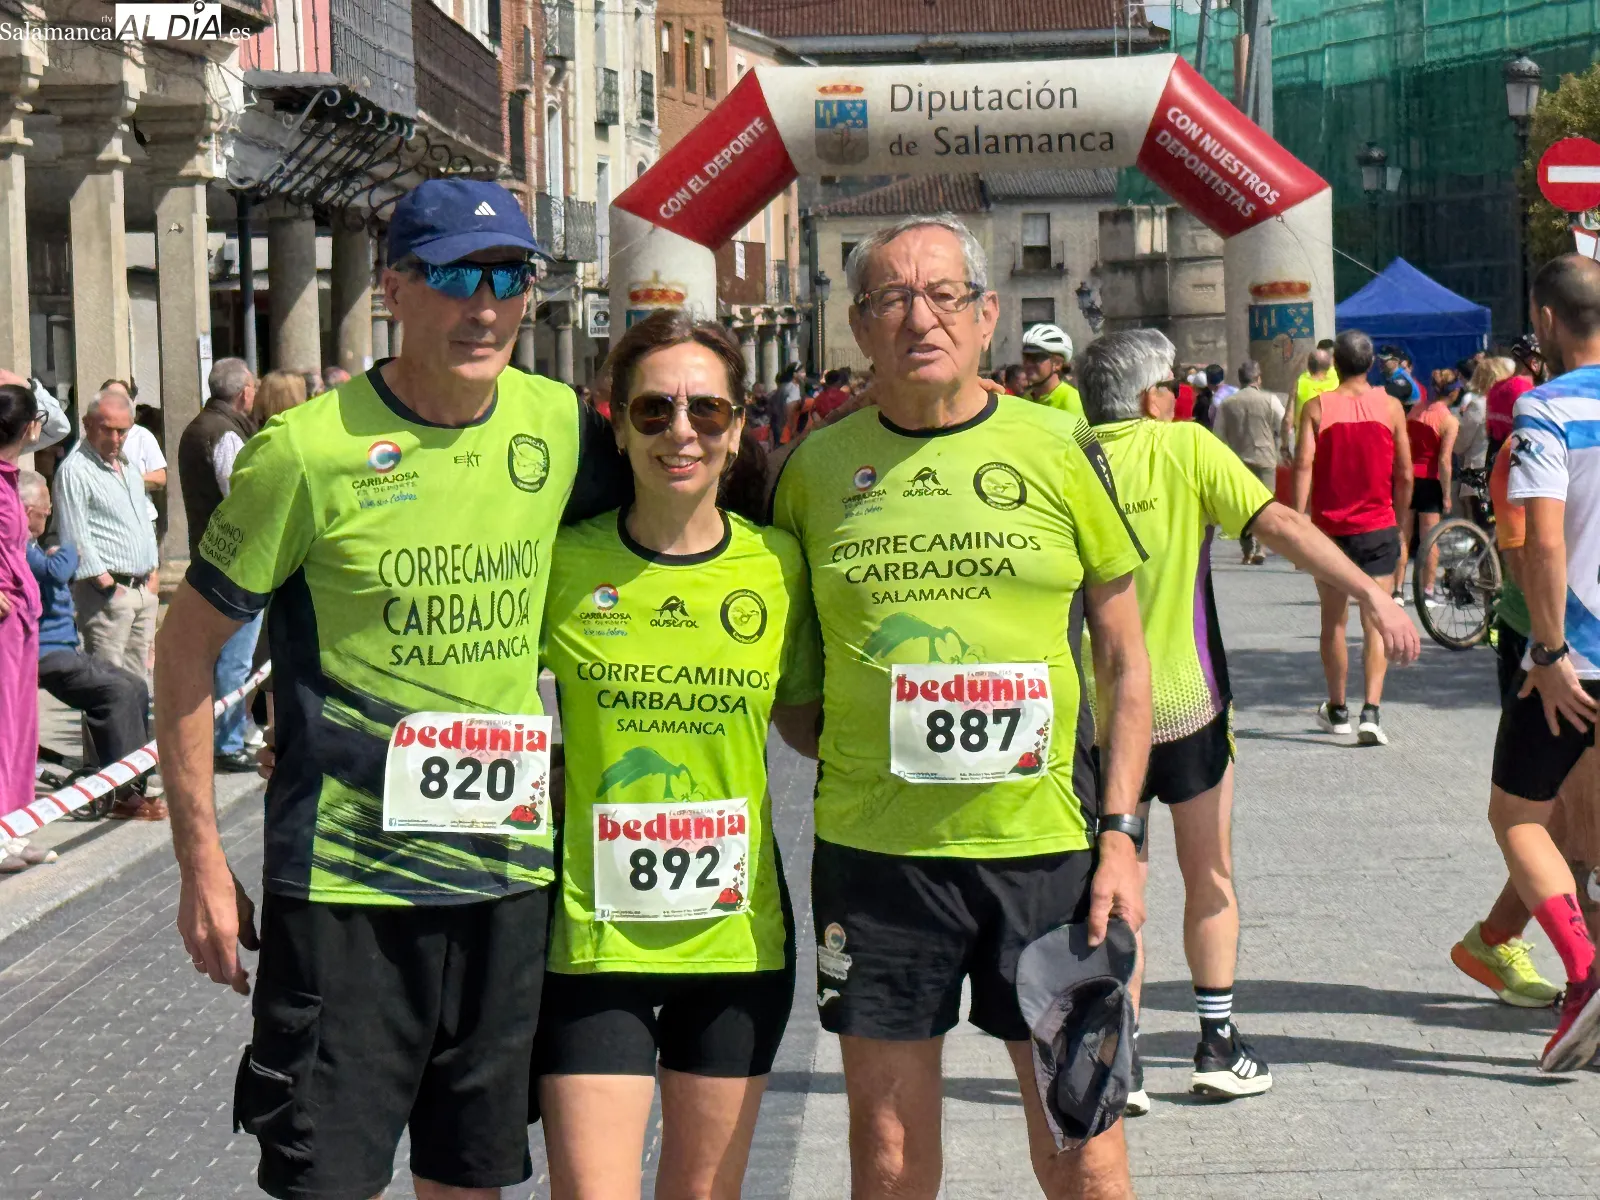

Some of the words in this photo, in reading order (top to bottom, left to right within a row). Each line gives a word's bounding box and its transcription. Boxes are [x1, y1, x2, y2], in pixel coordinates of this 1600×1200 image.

[889, 79, 1078, 120] Diputación
[888, 133, 919, 157] de
[933, 125, 1115, 156] Salamanca
[1166, 106, 1204, 141] CON
[1198, 132, 1281, 206] NUESTROS
[658, 187, 693, 219] CON
[687, 173, 710, 195] EL
[702, 116, 769, 179] DEPORTE
[1154, 129, 1257, 218] DEPORTISTAS
[351, 470, 419, 489] CARBAJOSA
[377, 539, 540, 588] CORRECAMINOS
[831, 531, 1042, 563] CORRECAMINOS
[845, 557, 1017, 584] CARBAJOSA
[382, 587, 530, 637] CARBAJOSA
[871, 586, 992, 605] SALAMANCA
[388, 634, 531, 666] SALAMANCA
[576, 661, 771, 690] CORRECAMINOS
[896, 672, 1049, 702] bedunia
[597, 689, 748, 714] CARBAJOSA
[394, 720, 547, 753] bedunia
[616, 718, 726, 736] SALAMANCA
[926, 707, 1022, 753] 887
[419, 755, 516, 802] 820
[598, 809, 746, 842] bedunia
[629, 845, 720, 892] 892
